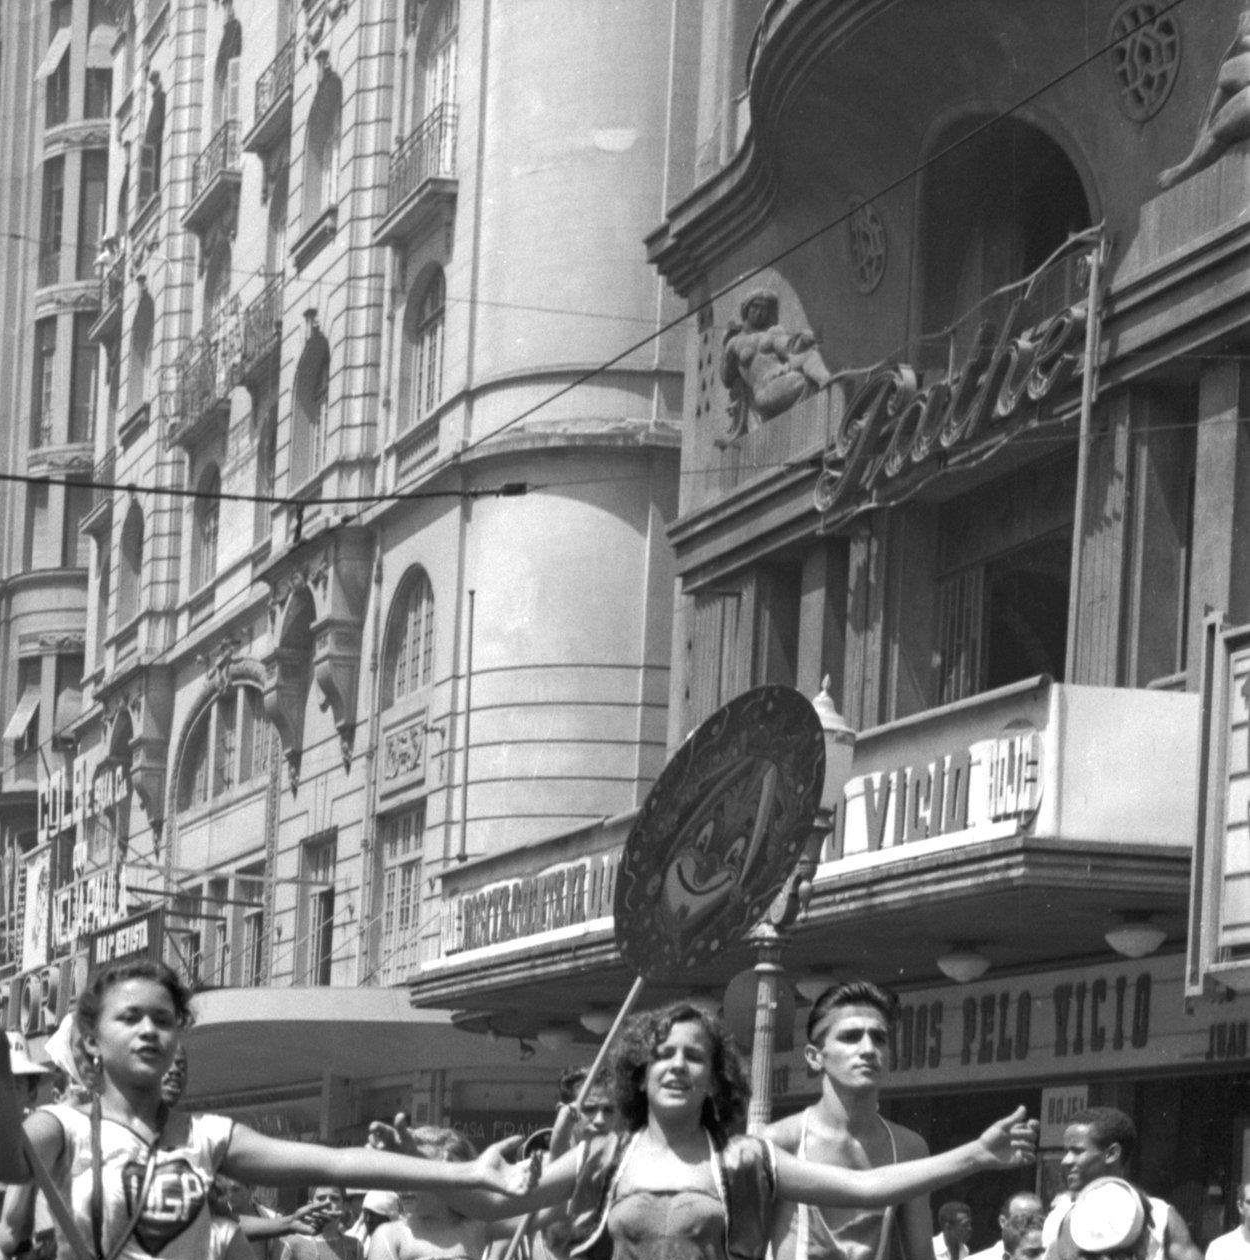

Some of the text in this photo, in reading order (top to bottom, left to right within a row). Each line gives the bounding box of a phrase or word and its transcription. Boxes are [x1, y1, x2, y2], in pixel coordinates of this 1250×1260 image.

[862, 749, 973, 852] VICIO
[960, 989, 1032, 1067] PELO
[1054, 972, 1151, 1058] VICIO
[453, 1121, 485, 1139] CASA
